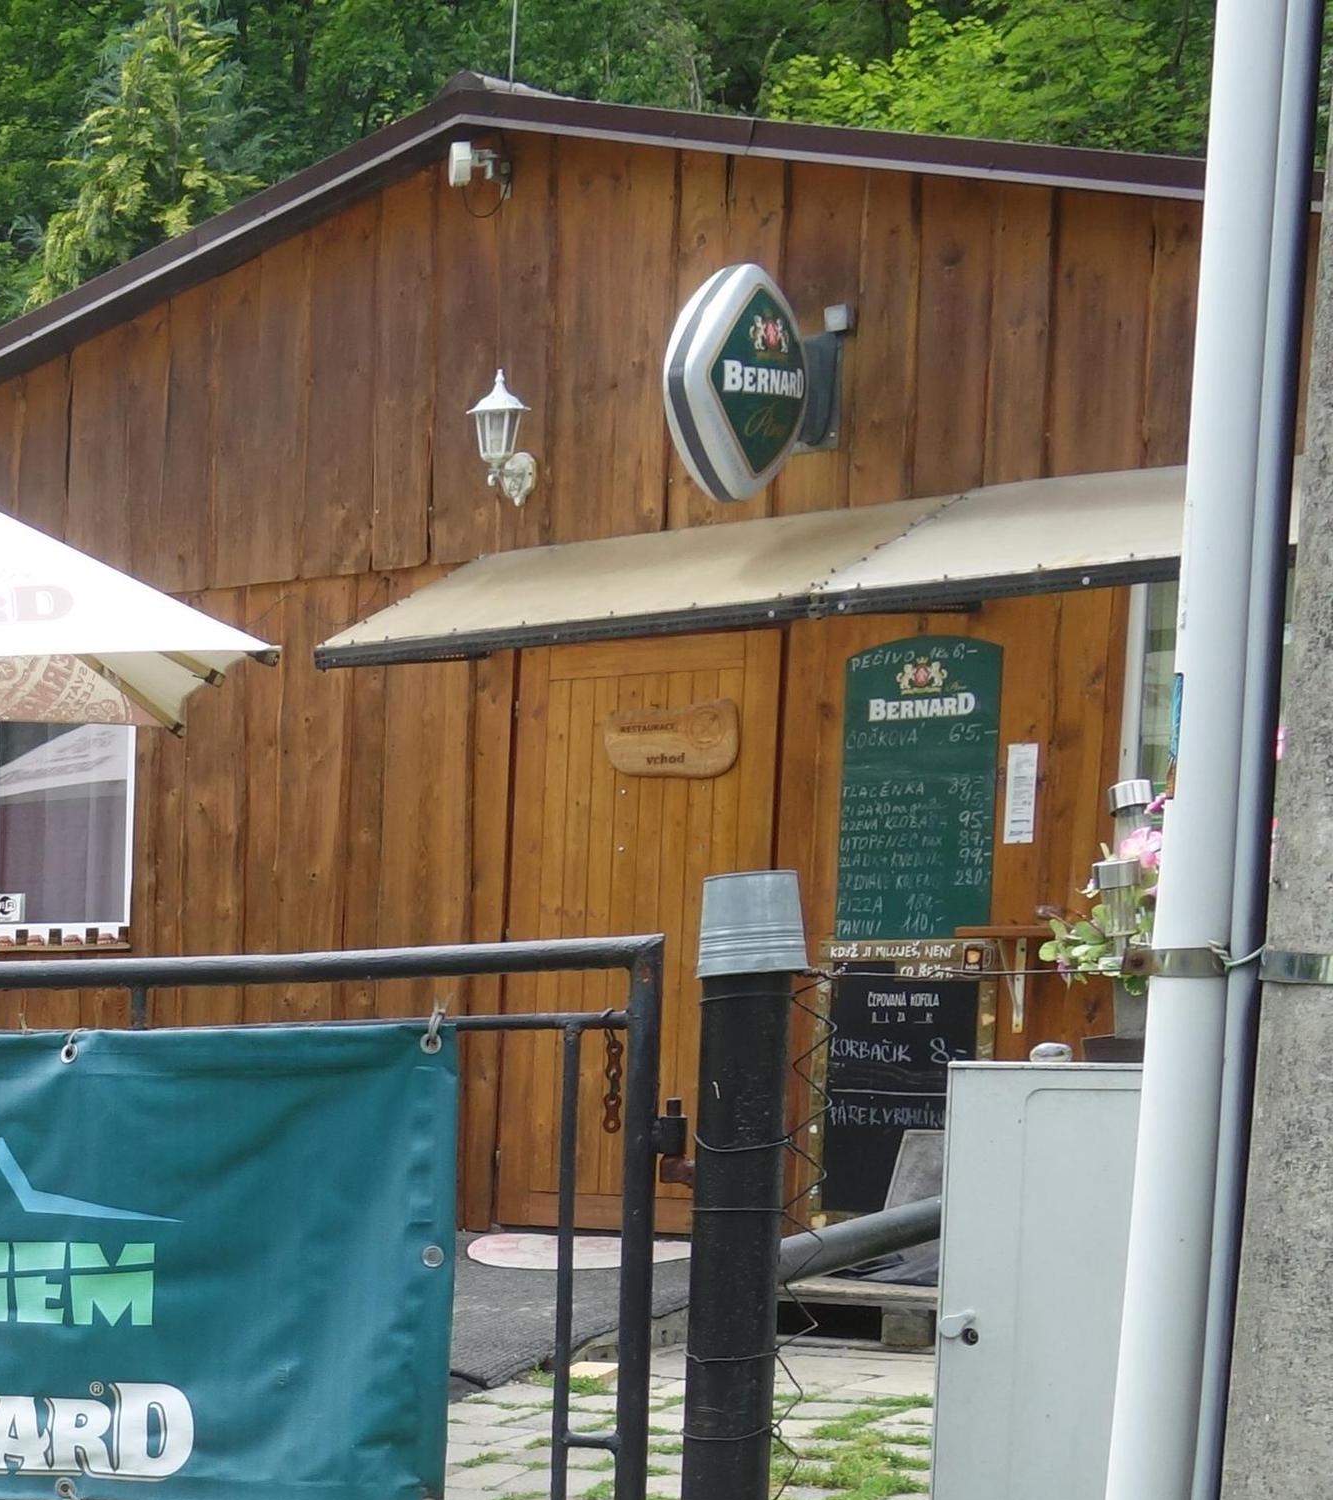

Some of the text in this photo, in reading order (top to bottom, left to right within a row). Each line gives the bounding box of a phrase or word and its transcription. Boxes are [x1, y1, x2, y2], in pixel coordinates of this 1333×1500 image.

[723, 359, 805, 399] BERNARD
[868, 692, 976, 722] BERNARD
[646, 752, 686, 765] vchod
[837, 896, 882, 913] PIZZA
[830, 943, 859, 958] KDYŽ
[924, 944, 956, 958] NENÍ
[910, 992, 940, 1007] KOFOLA
[830, 1100, 880, 1126] PÁREK
